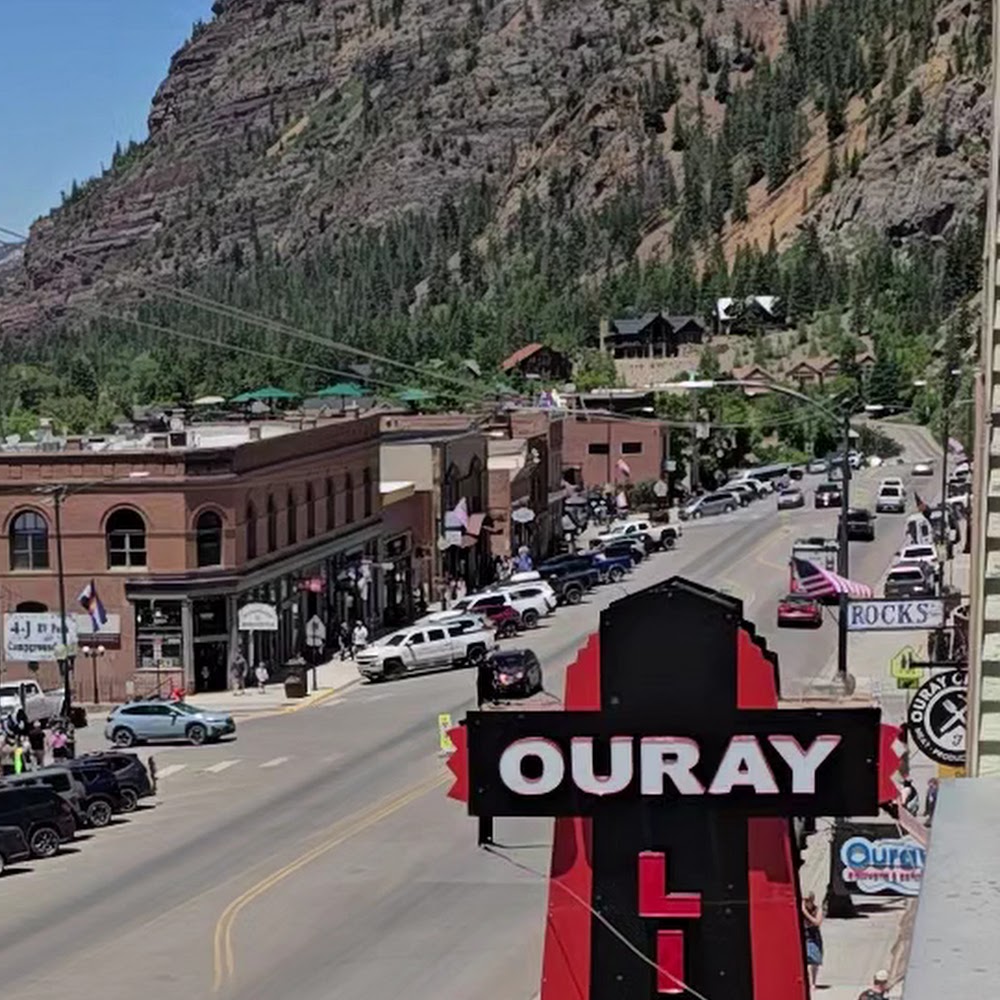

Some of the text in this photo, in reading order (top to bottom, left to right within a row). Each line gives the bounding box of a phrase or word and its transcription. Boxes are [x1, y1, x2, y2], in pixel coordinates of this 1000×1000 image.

[851, 603, 929, 625] ROCKS
[910, 675, 948, 723] OURAY
[499, 735, 841, 796] OURAY
